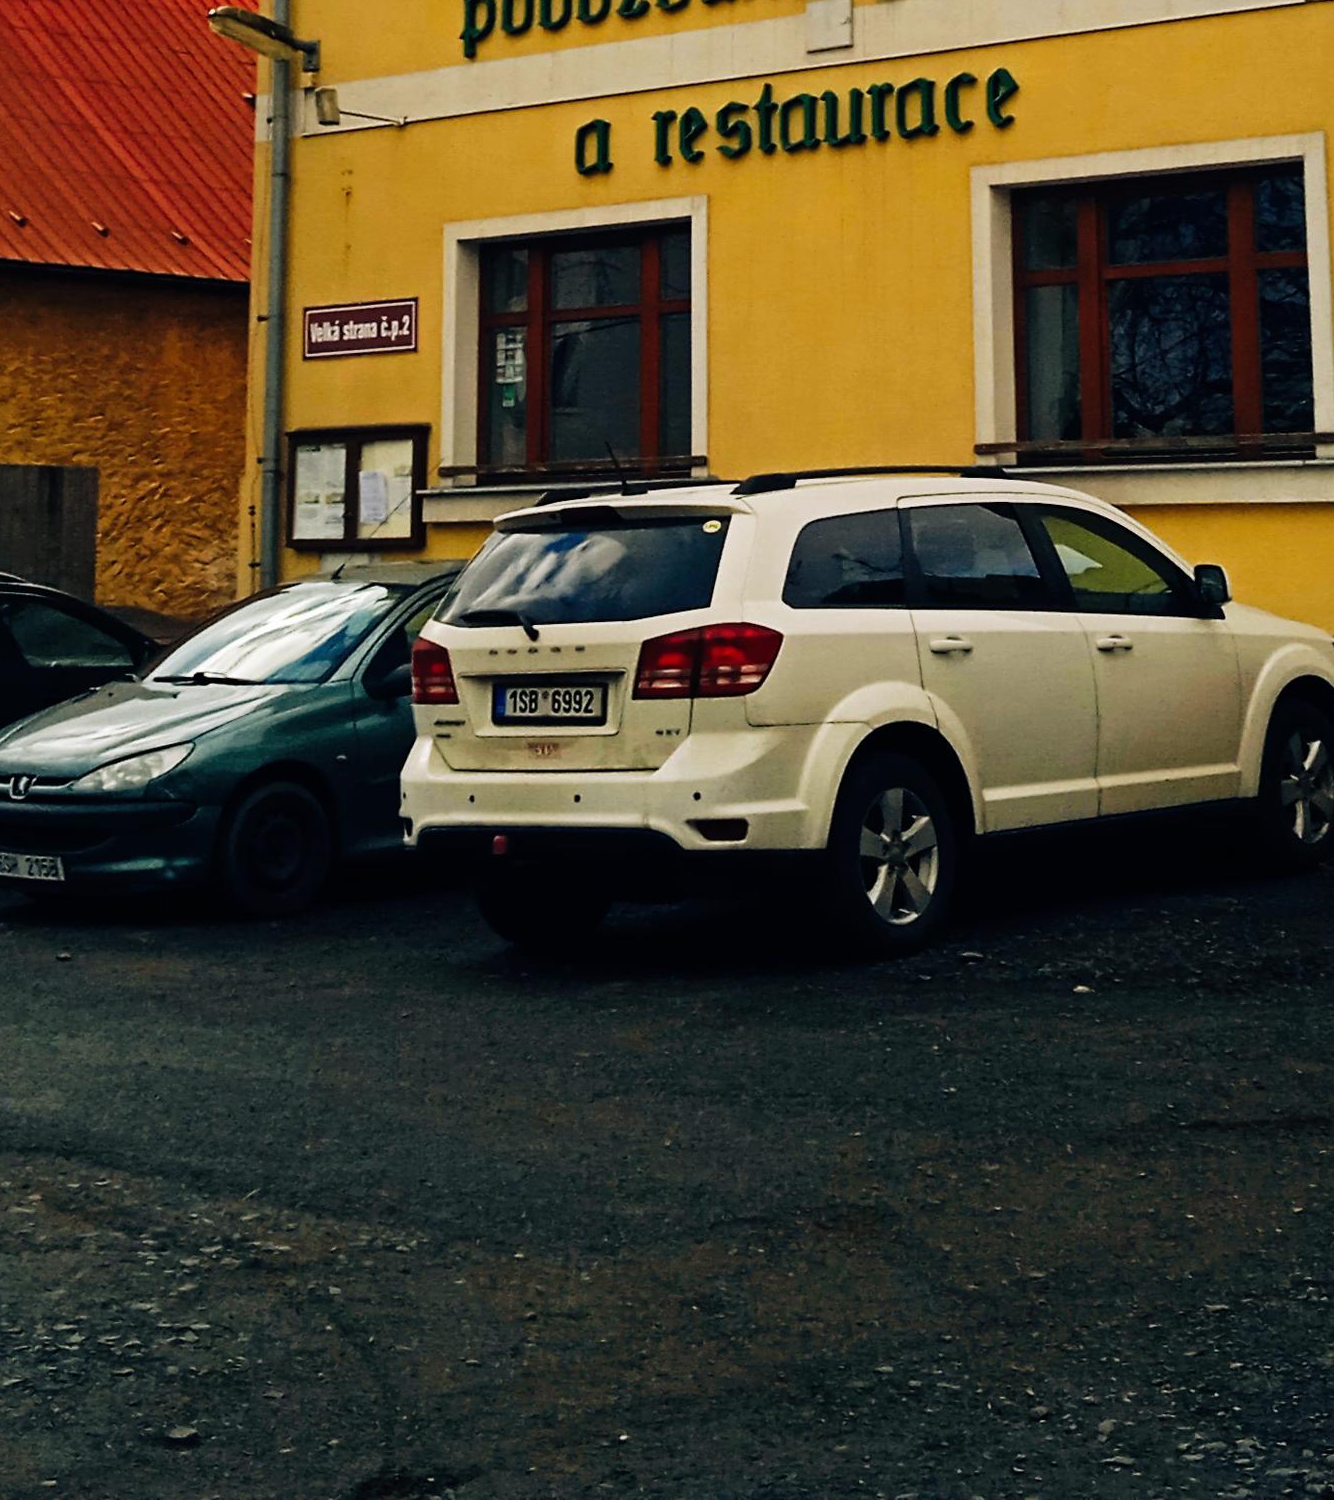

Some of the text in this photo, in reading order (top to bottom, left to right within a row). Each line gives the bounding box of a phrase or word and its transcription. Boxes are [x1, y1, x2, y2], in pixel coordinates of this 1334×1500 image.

[575, 68, 1021, 178] a restaurace
[310, 320, 340, 343] Velká
[342, 320, 378, 341] strana
[508, 689, 595, 714] 1SB 6992
